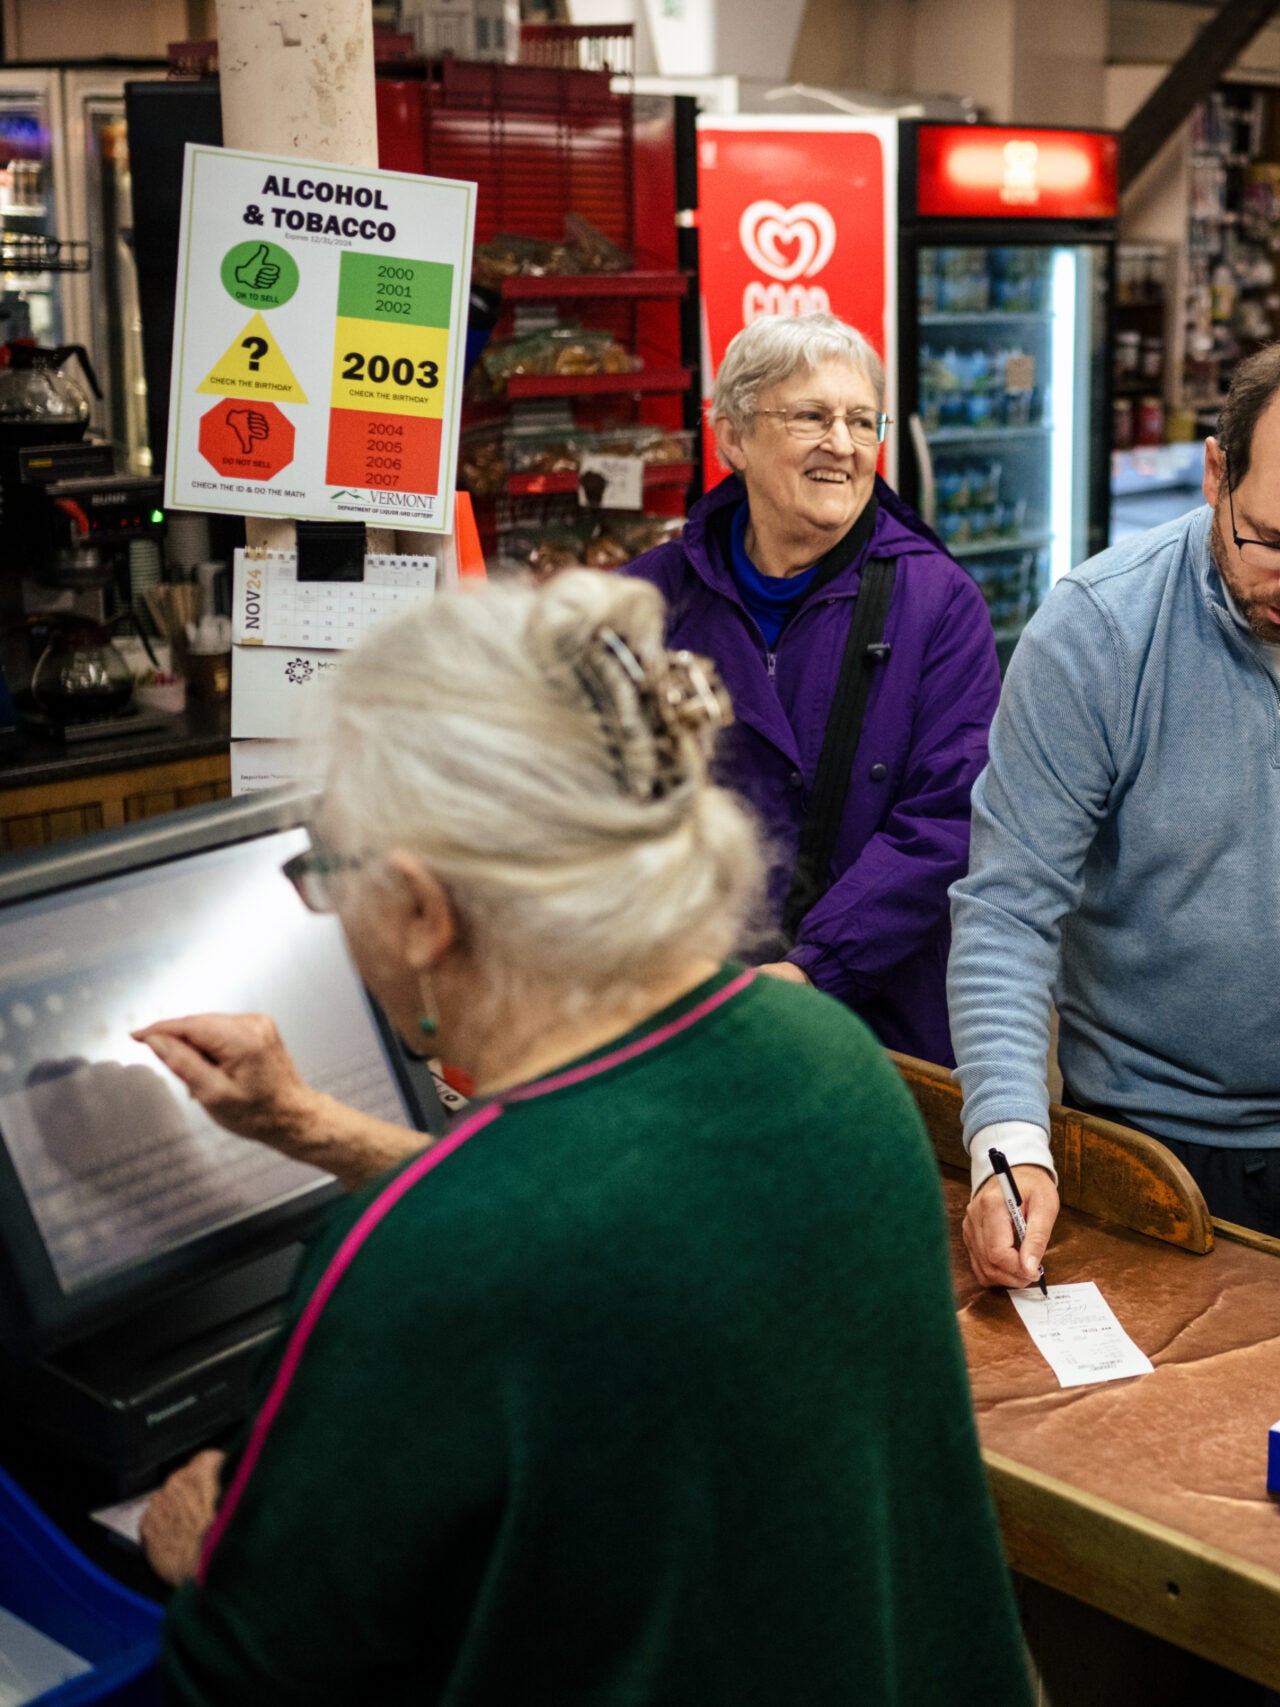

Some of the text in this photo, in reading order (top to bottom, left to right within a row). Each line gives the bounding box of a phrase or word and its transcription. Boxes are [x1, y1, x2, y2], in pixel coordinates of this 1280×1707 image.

[262, 175, 389, 211] ALCOHOL
[243, 205, 396, 242] & TOBACCO
[377, 266, 414, 281] 2000
[249, 293, 259, 301] TO
[260, 295, 279, 303] SELL
[376, 283, 412, 298] 2001
[375, 299, 412, 315] 2002
[241, 336, 269, 371] ?
[342, 352, 439, 389] 2003
[210, 376, 293, 393] CHECK THE BIRTHDAY
[348, 388, 429, 404] CHECK THE BIRTHDAY
[368, 422, 404, 436] 2004
[367, 439, 403, 453] 2005
[222, 458, 271, 469] DO NOT SELL
[365, 456, 402, 470] 2006
[365, 472, 400, 486] 2007
[191, 481, 218, 490] CHECK
[220, 483, 235, 492] THE
[254, 487, 266, 495] DO
[267, 489, 283, 497] THE
[284, 490, 306, 499] MATH
[369, 490, 435, 509] VERMONT
[337, 505, 371, 514] DEPARTMENT
[379, 508, 399, 516] LIQUOR
[399, 509, 411, 517] AND
[411, 511, 434, 519] LOTTERY
